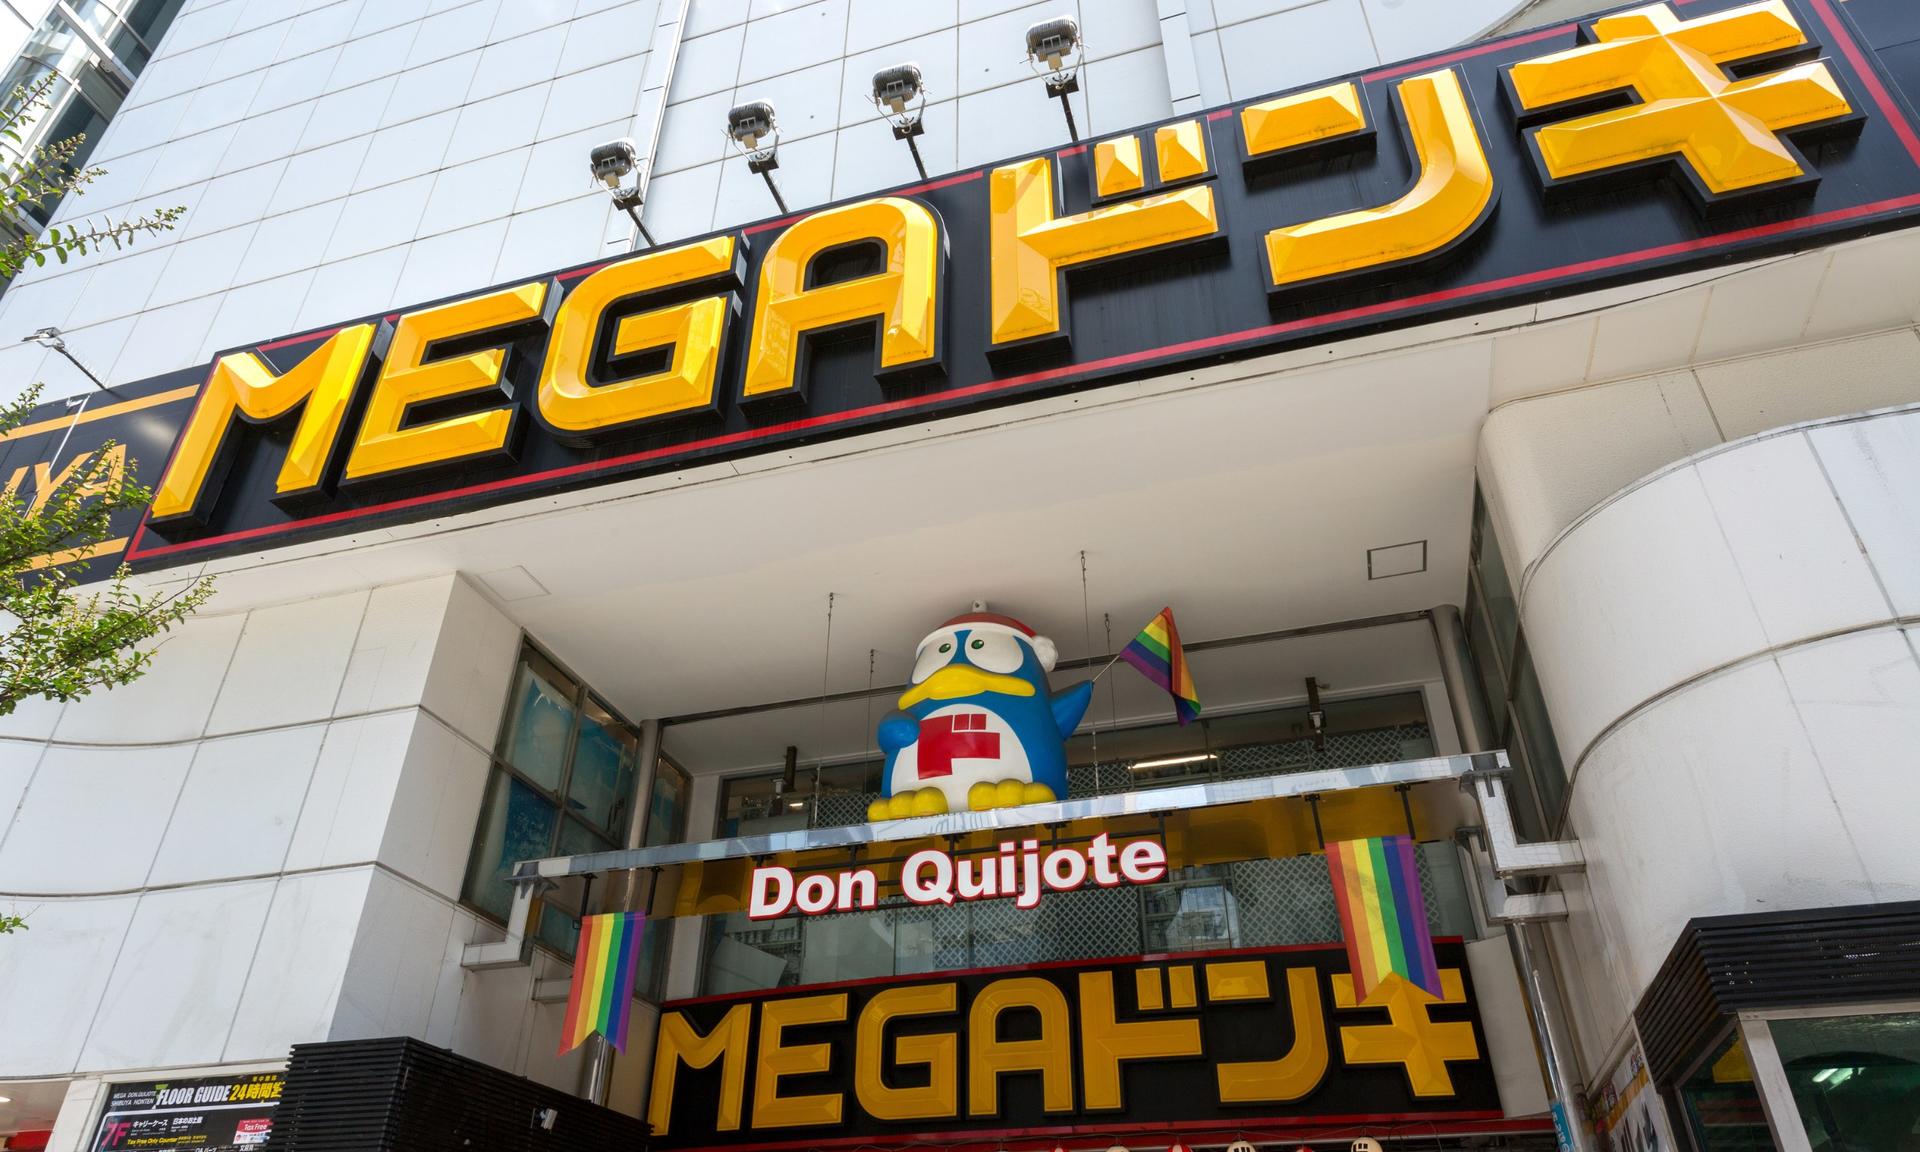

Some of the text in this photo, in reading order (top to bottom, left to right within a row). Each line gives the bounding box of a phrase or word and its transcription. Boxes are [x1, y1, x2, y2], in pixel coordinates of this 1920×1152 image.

[747, 832, 1168, 921] Don Quijote
[156, 1085, 231, 1105] FLOOR GUIDE
[132, 1119, 169, 1128] キャリーケース
[244, 1123, 254, 1131] Tax
[101, 1122, 131, 1147] 7F
